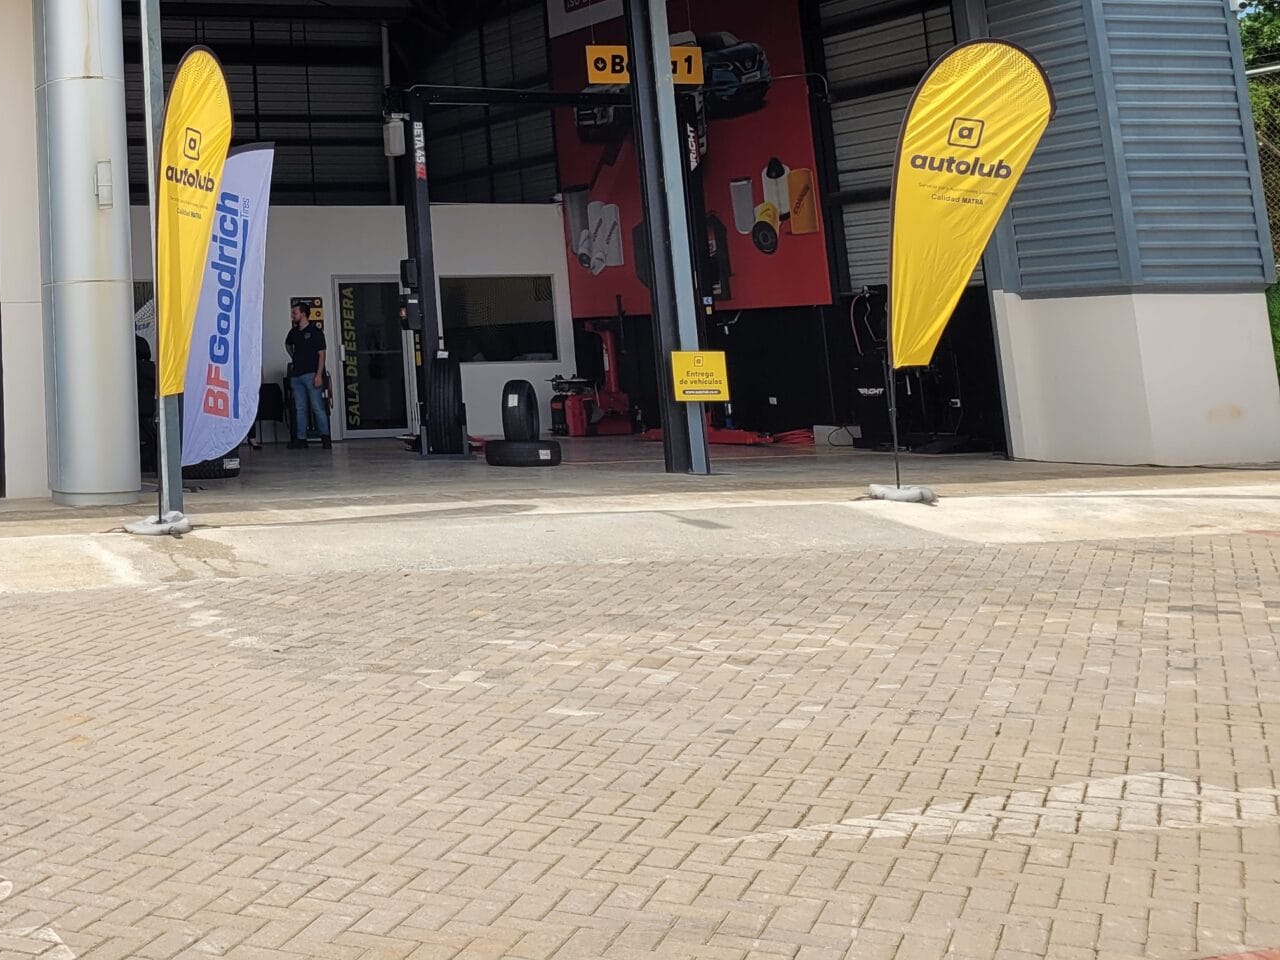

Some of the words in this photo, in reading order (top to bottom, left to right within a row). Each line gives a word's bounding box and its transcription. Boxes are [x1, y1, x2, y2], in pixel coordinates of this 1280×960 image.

[683, 55, 693, 75] 1
[412, 121, 425, 149] BETA
[414, 149, 426, 163] 45
[910, 154, 1012, 180] autolub
[165, 165, 215, 193] autolub
[240, 197, 250, 219] Tires
[931, 193, 961, 203] Calidad
[961, 197, 984, 206] MATRA
[203, 190, 240, 419] BFGoodrich
[342, 287, 358, 352] ESPERA
[345, 355, 359, 377] DE
[686, 370, 714, 378] Entrega
[346, 382, 361, 426] SALA
